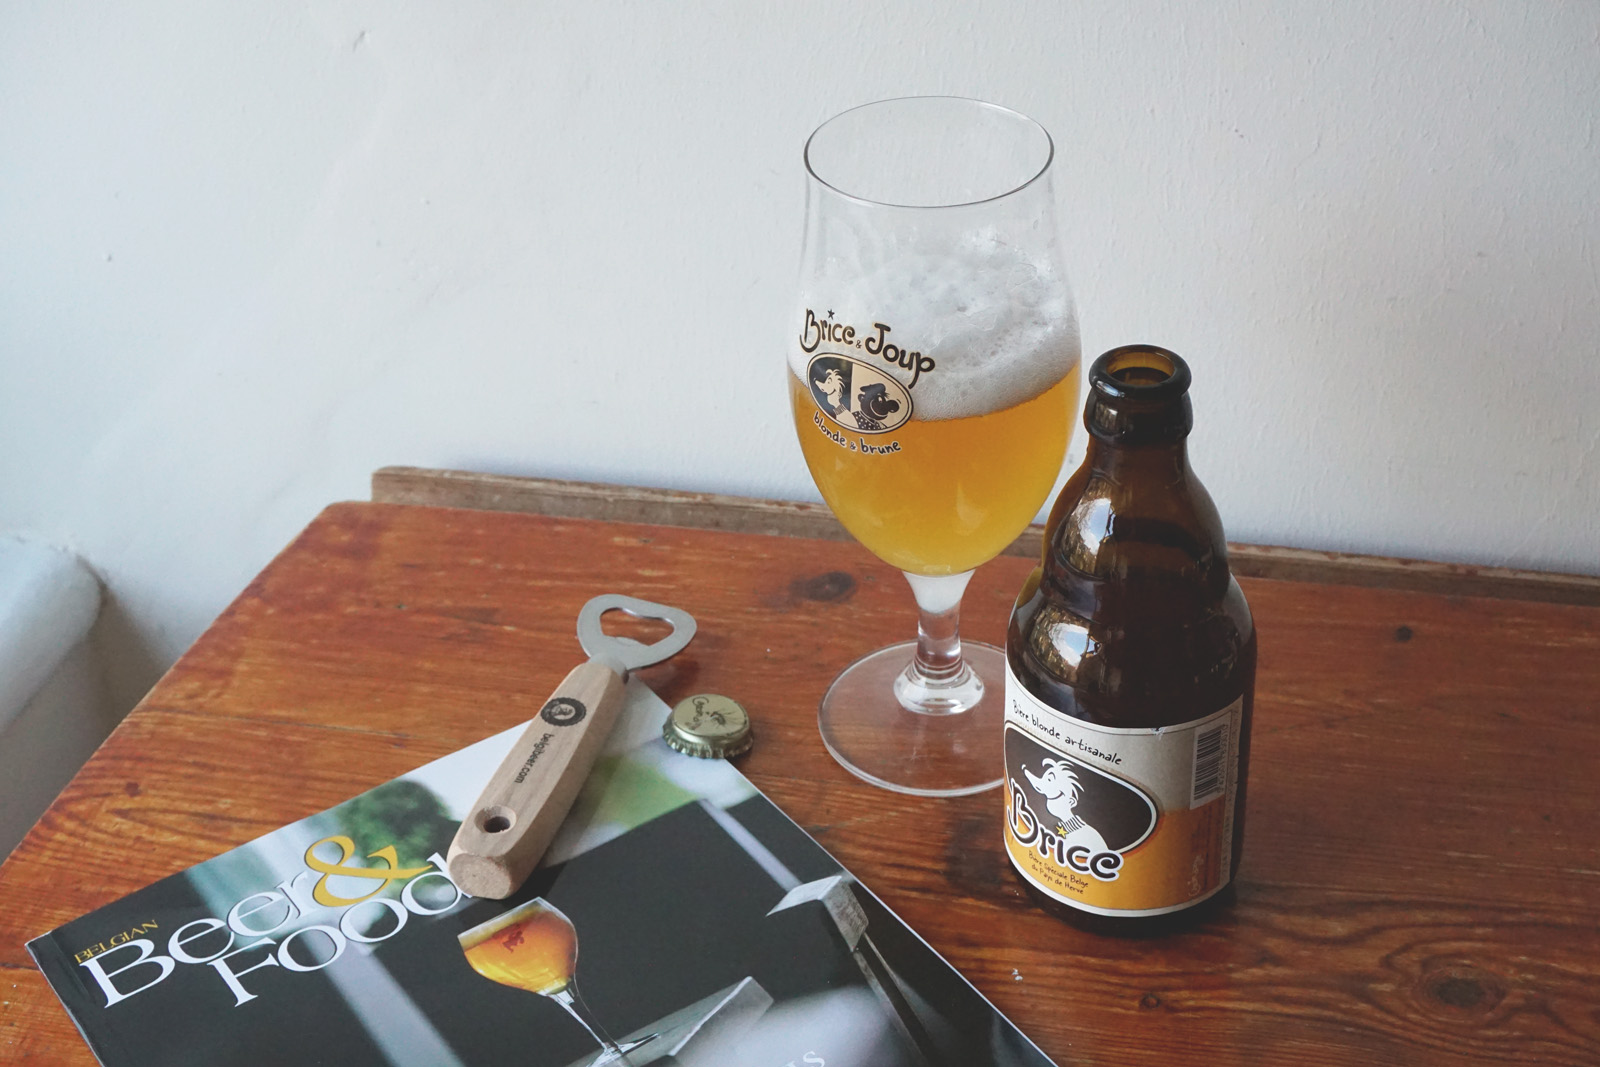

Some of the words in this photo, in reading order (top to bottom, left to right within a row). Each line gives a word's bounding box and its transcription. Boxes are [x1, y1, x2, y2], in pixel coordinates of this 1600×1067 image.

[800, 308, 855, 352] Brice
[855, 340, 862, 349] &
[865, 322, 936, 389] Joup
[814, 411, 847, 446] blonde
[860, 437, 901, 454] brune
[1031, 714, 1061, 740] blonde
[1064, 736, 1122, 765] artisanale
[1008, 779, 1122, 881] Brice
[1070, 874, 1089, 889] Belge
[74, 919, 158, 964] BELGIAN
[79, 871, 308, 1008] Beer
[304, 835, 434, 907] &
[207, 852, 473, 1007] Food
